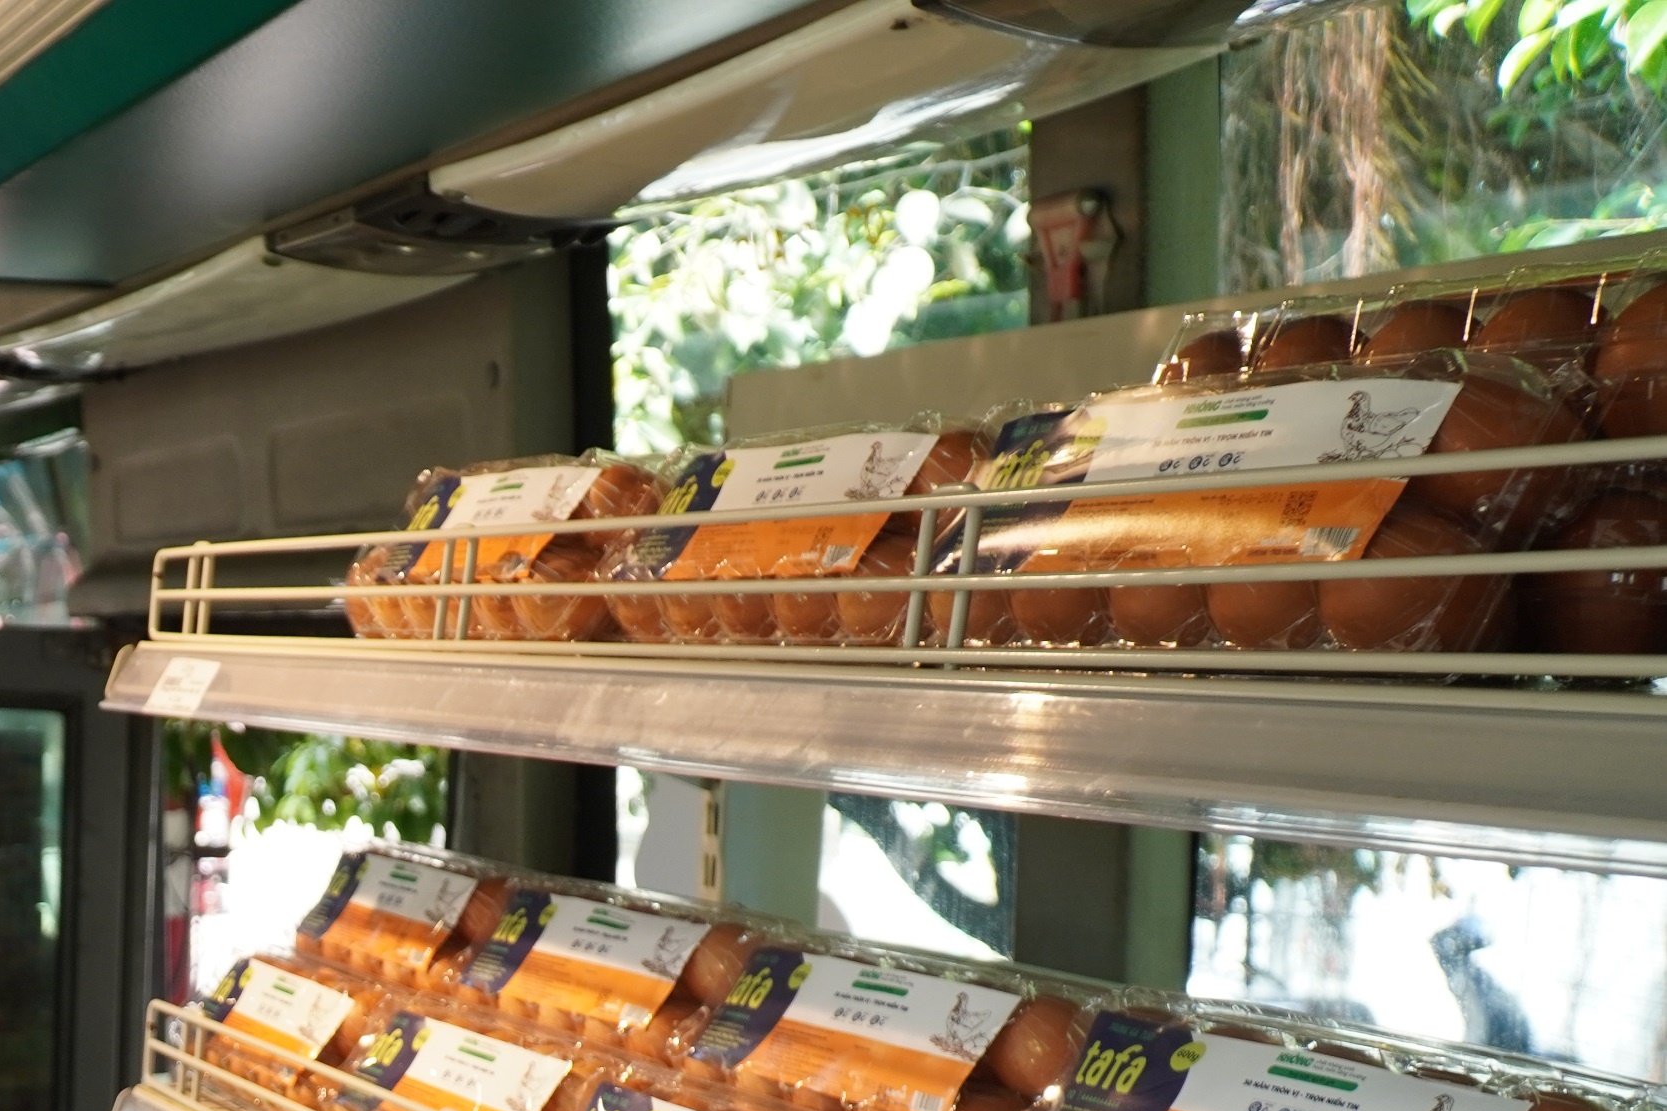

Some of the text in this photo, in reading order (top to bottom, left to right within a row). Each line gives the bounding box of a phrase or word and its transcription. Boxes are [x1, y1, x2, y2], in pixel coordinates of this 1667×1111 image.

[1177, 1050, 1200, 1062] 600g
[1075, 1040, 1147, 1095] tafa
[1346, 1101, 1360, 1111] TIN
